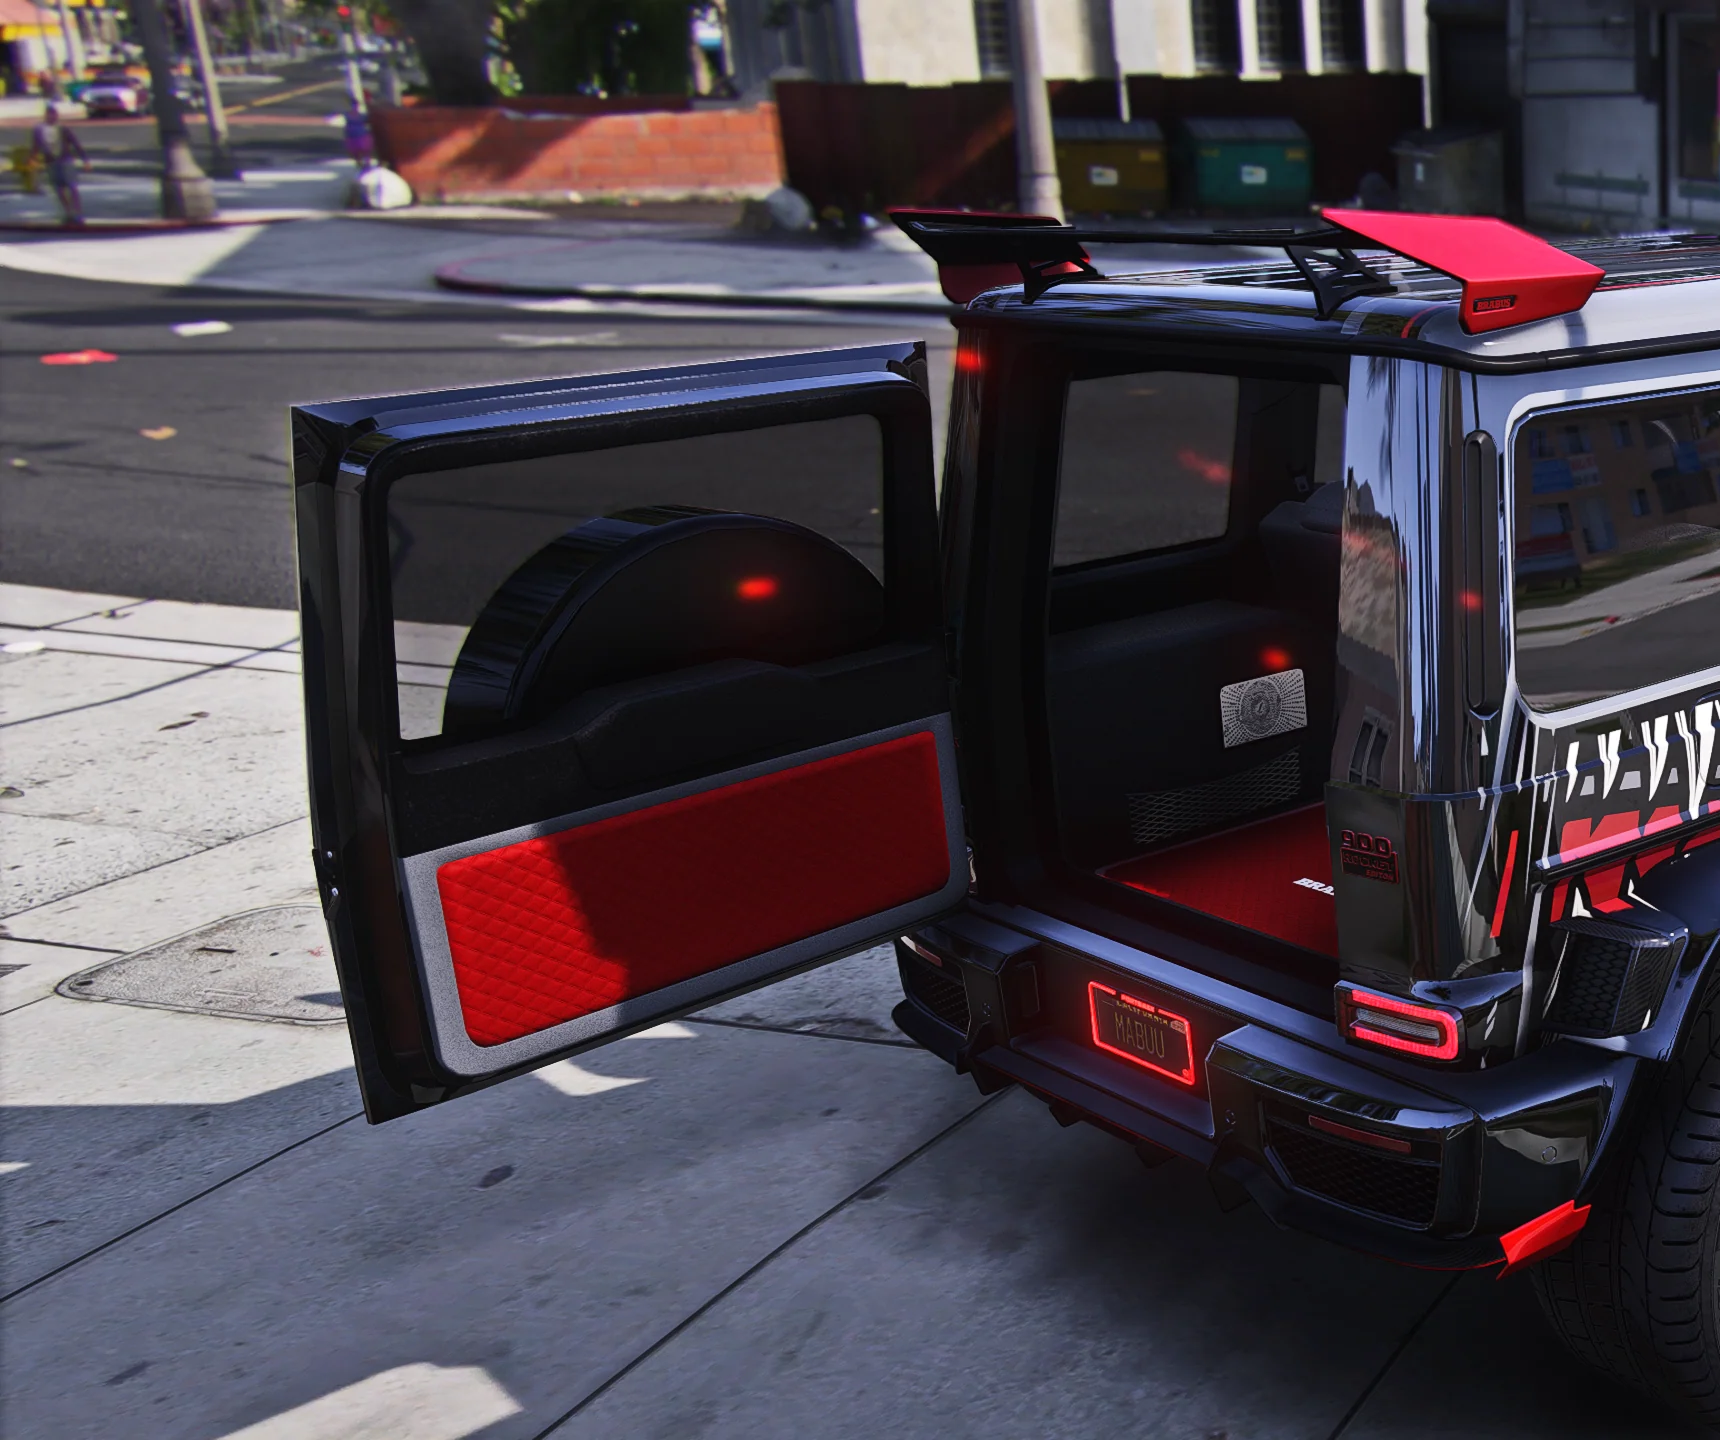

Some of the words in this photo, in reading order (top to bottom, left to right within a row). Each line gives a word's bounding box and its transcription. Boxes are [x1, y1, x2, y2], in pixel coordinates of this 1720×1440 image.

[1476, 298, 1512, 311] BRABUS
[1341, 829, 1393, 858] 900
[1113, 1011, 1166, 1059] MABUU
